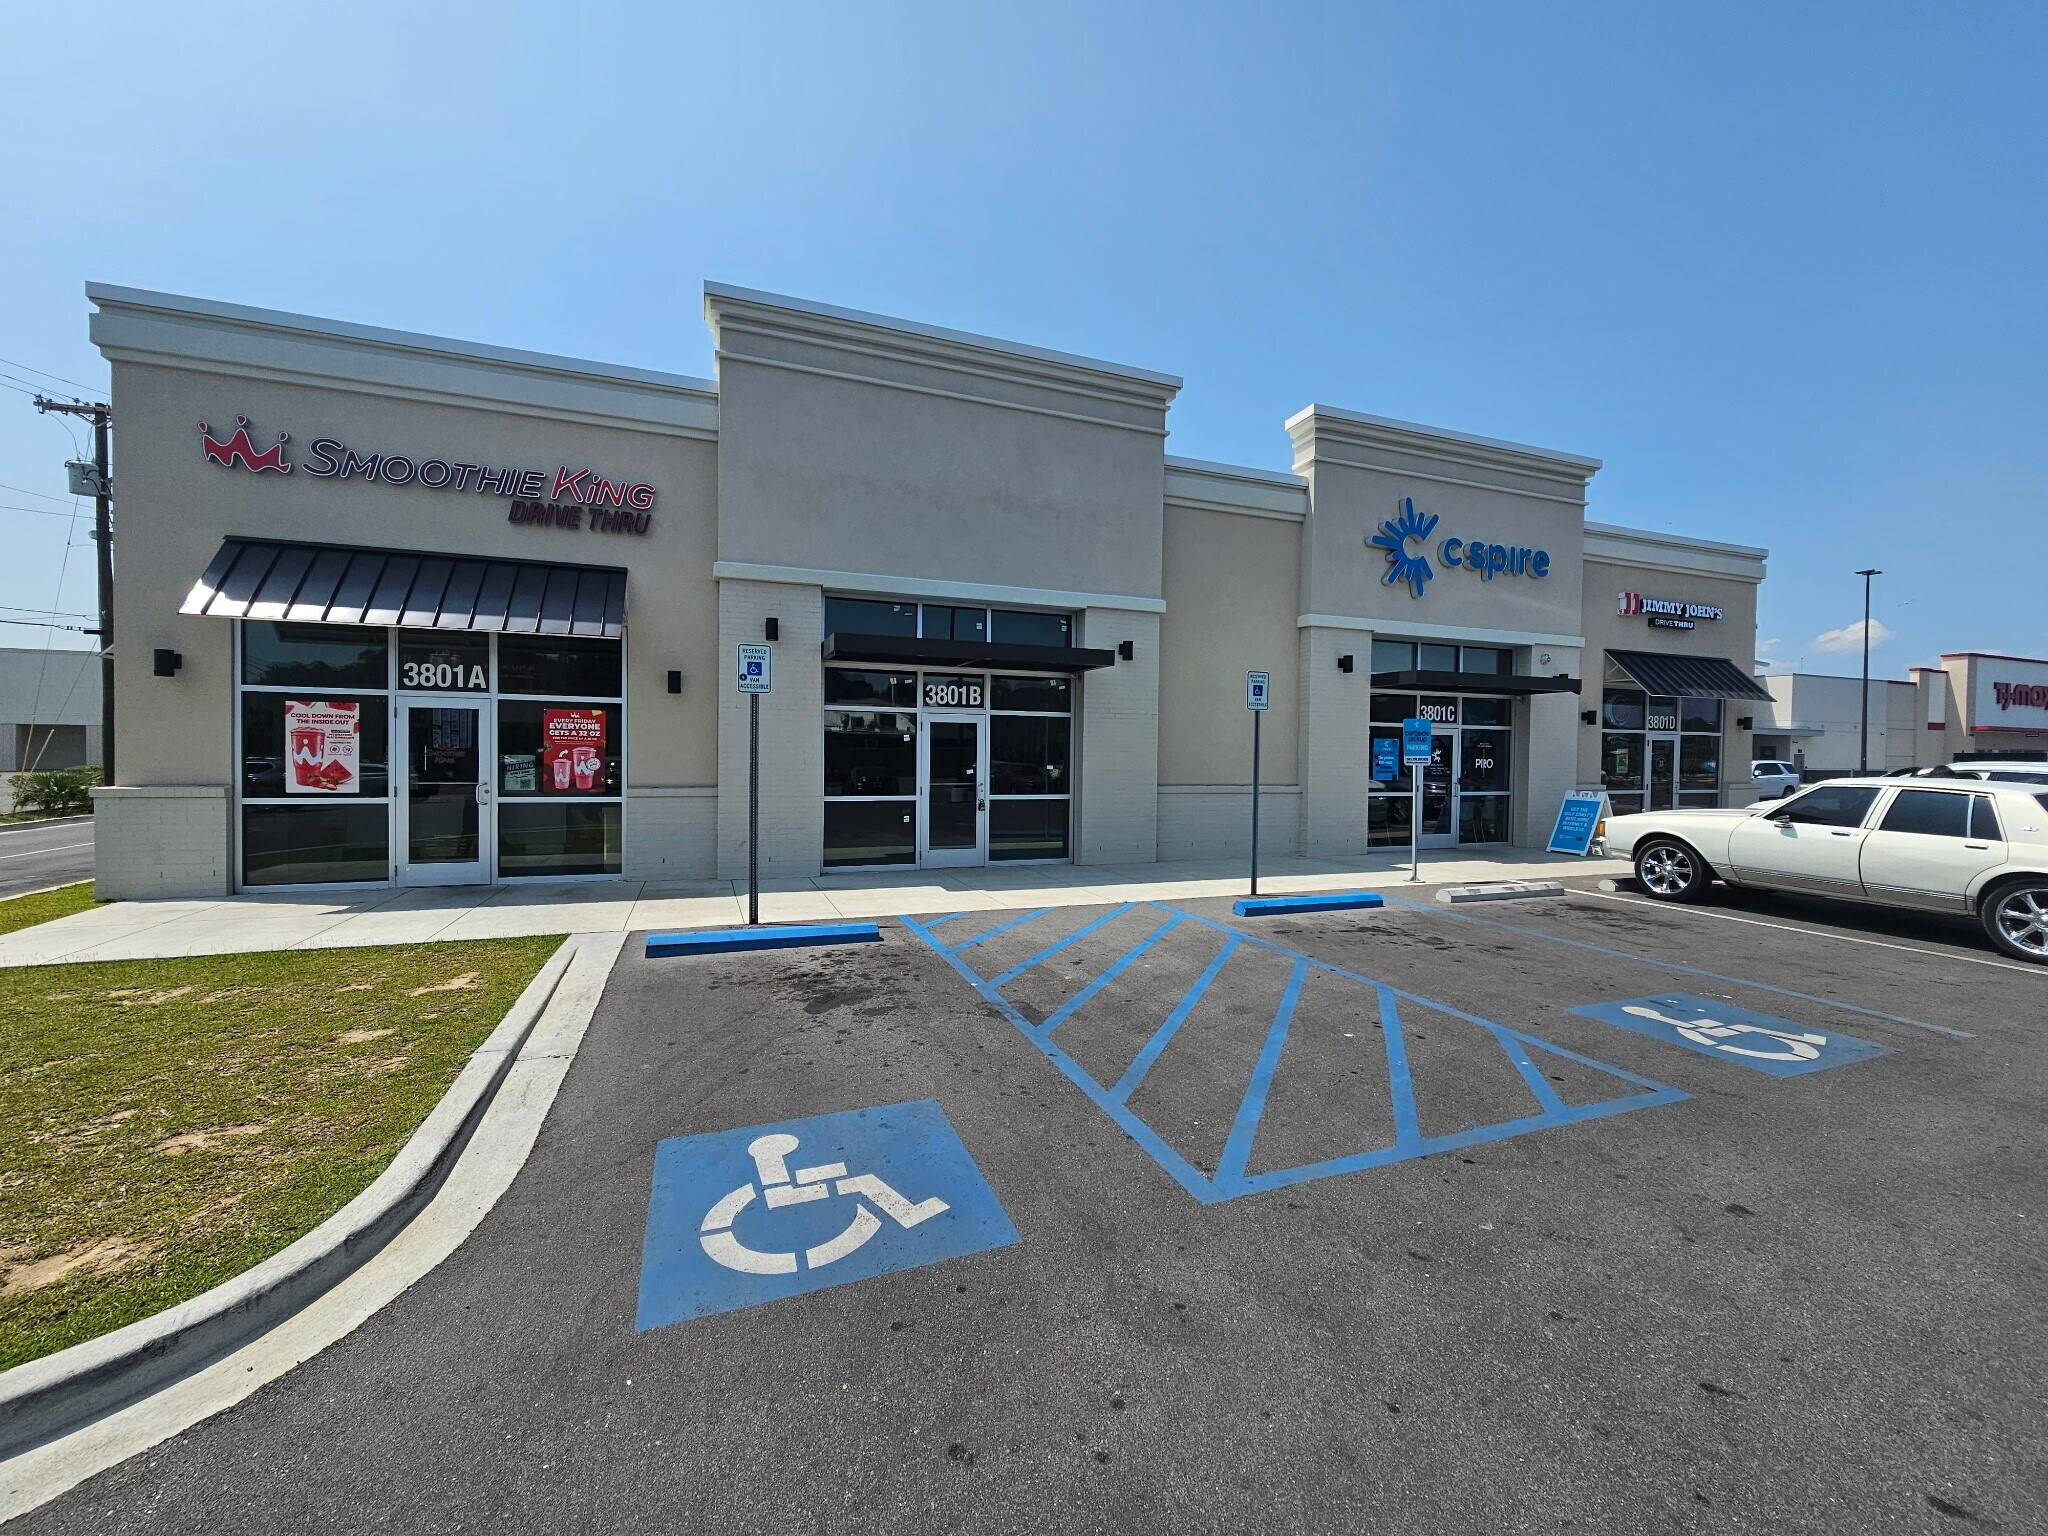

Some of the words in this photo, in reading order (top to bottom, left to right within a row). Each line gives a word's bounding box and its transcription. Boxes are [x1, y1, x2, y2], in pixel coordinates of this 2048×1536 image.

[302, 437, 546, 498] SMOOTHIE
[507, 500, 583, 531] DRIVE
[588, 507, 652, 536] THRU
[1642, 599, 1684, 615] JIMMY
[1684, 604, 1723, 620] JOHN'S
[1655, 618, 1673, 627] DRIVE
[1674, 620, 1694, 629] THRU
[403, 662, 487, 689] 3801A
[925, 684, 982, 706] 3801B
[1420, 705, 1455, 721] 3801C
[549, 723, 601, 731] EVERYONE
[1648, 715, 1676, 730] 3801D
[506, 762, 534, 771] HIRING
